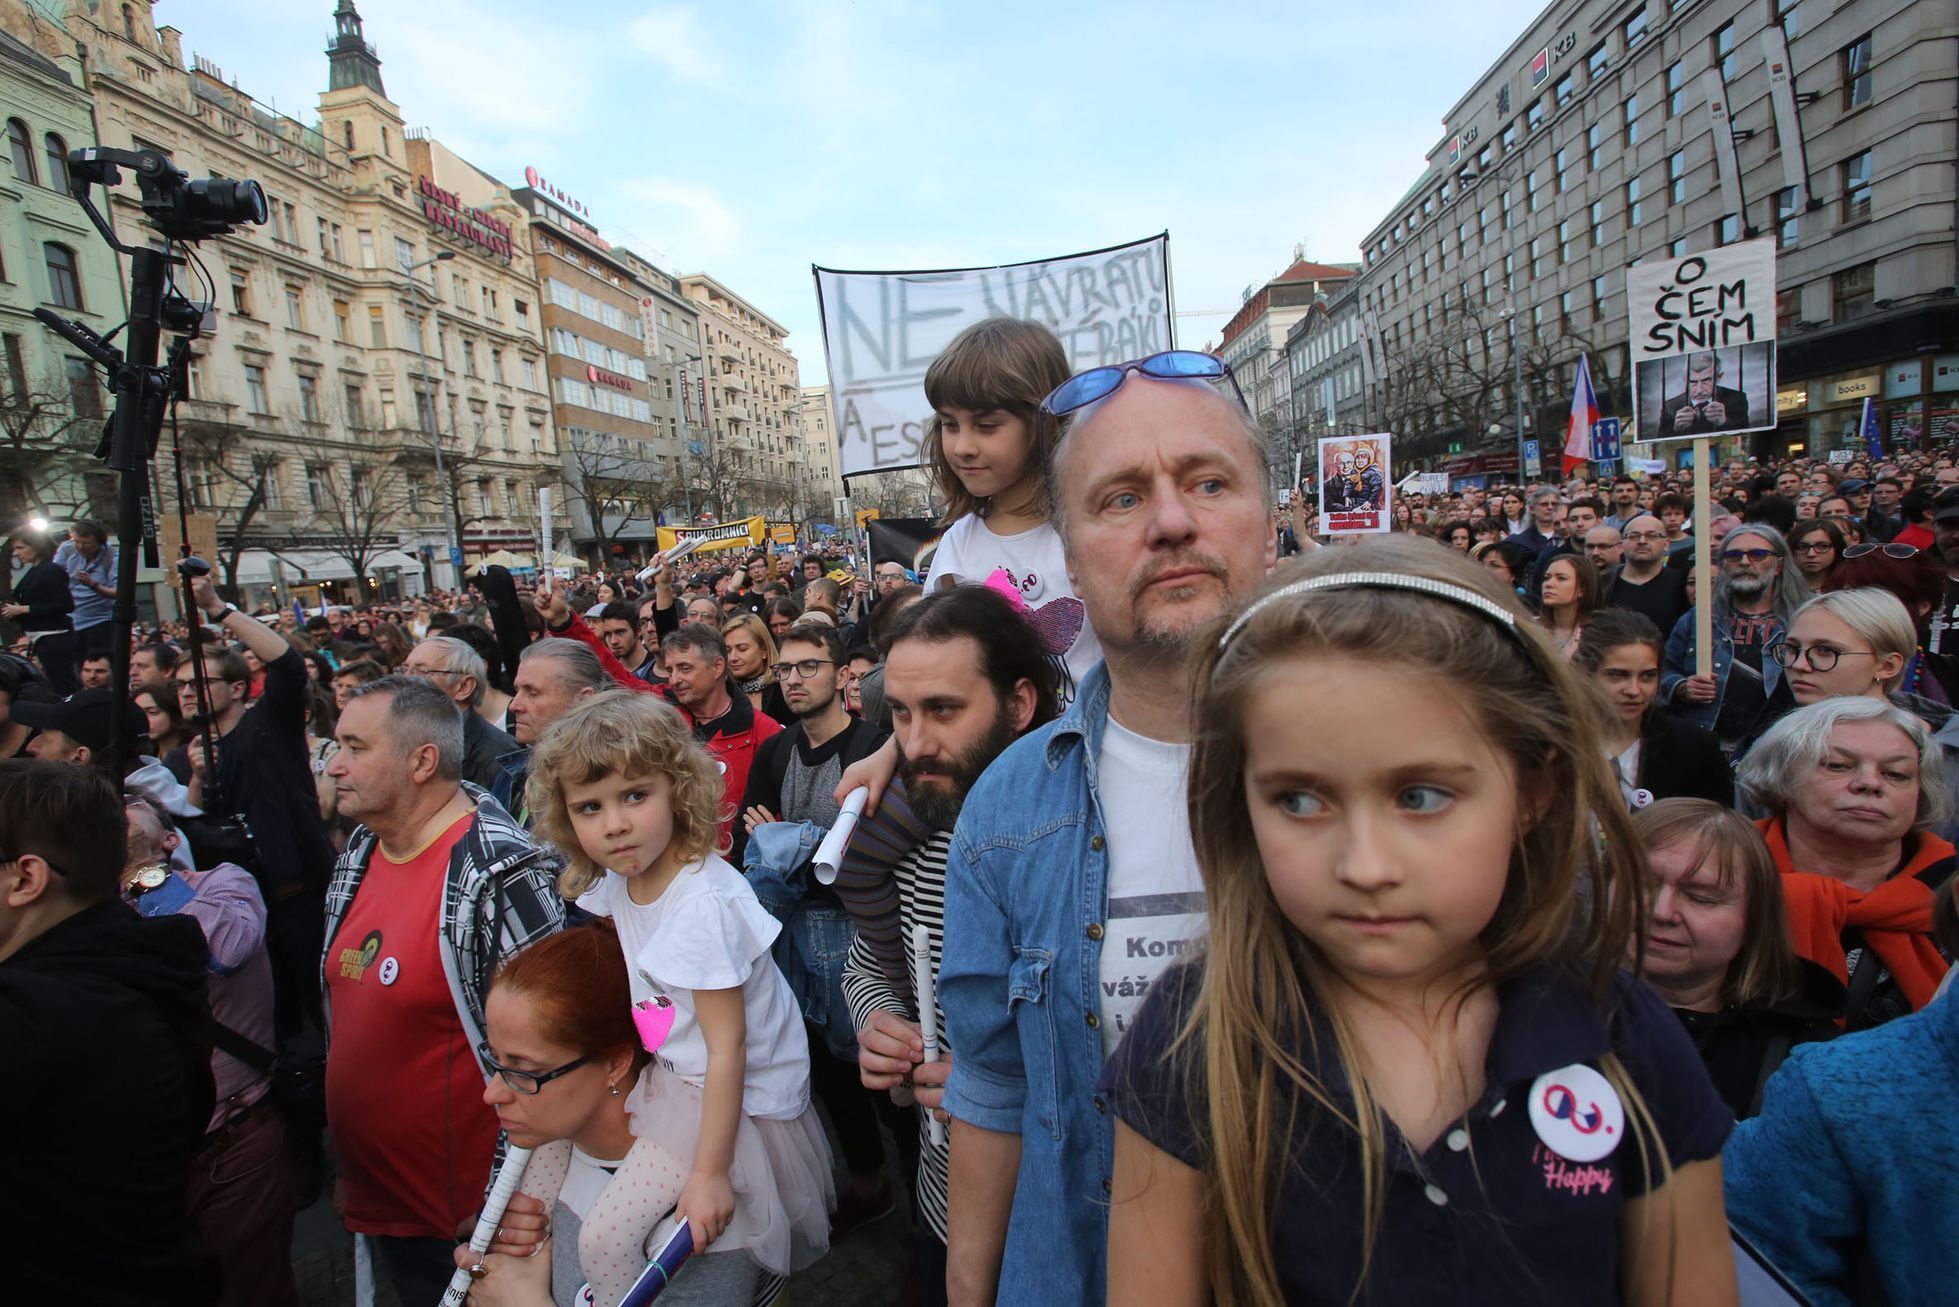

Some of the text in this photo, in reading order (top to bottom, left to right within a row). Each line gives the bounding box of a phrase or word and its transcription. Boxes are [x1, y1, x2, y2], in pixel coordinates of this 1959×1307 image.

[1552, 31, 1576, 64] KB
[1463, 127, 1478, 149] KB
[540, 177, 590, 218] RAMADA
[1675, 257, 1707, 285] O
[1655, 279, 1745, 320] ČEM
[835, 273, 966, 387] NE
[1643, 312, 1755, 352] SNÍM
[1838, 384, 1867, 395] books
[139, 496, 154, 538] GITZO
[676, 523, 749, 546] SOUKROMNÍCI
[1543, 1162, 1613, 1196] Happy
